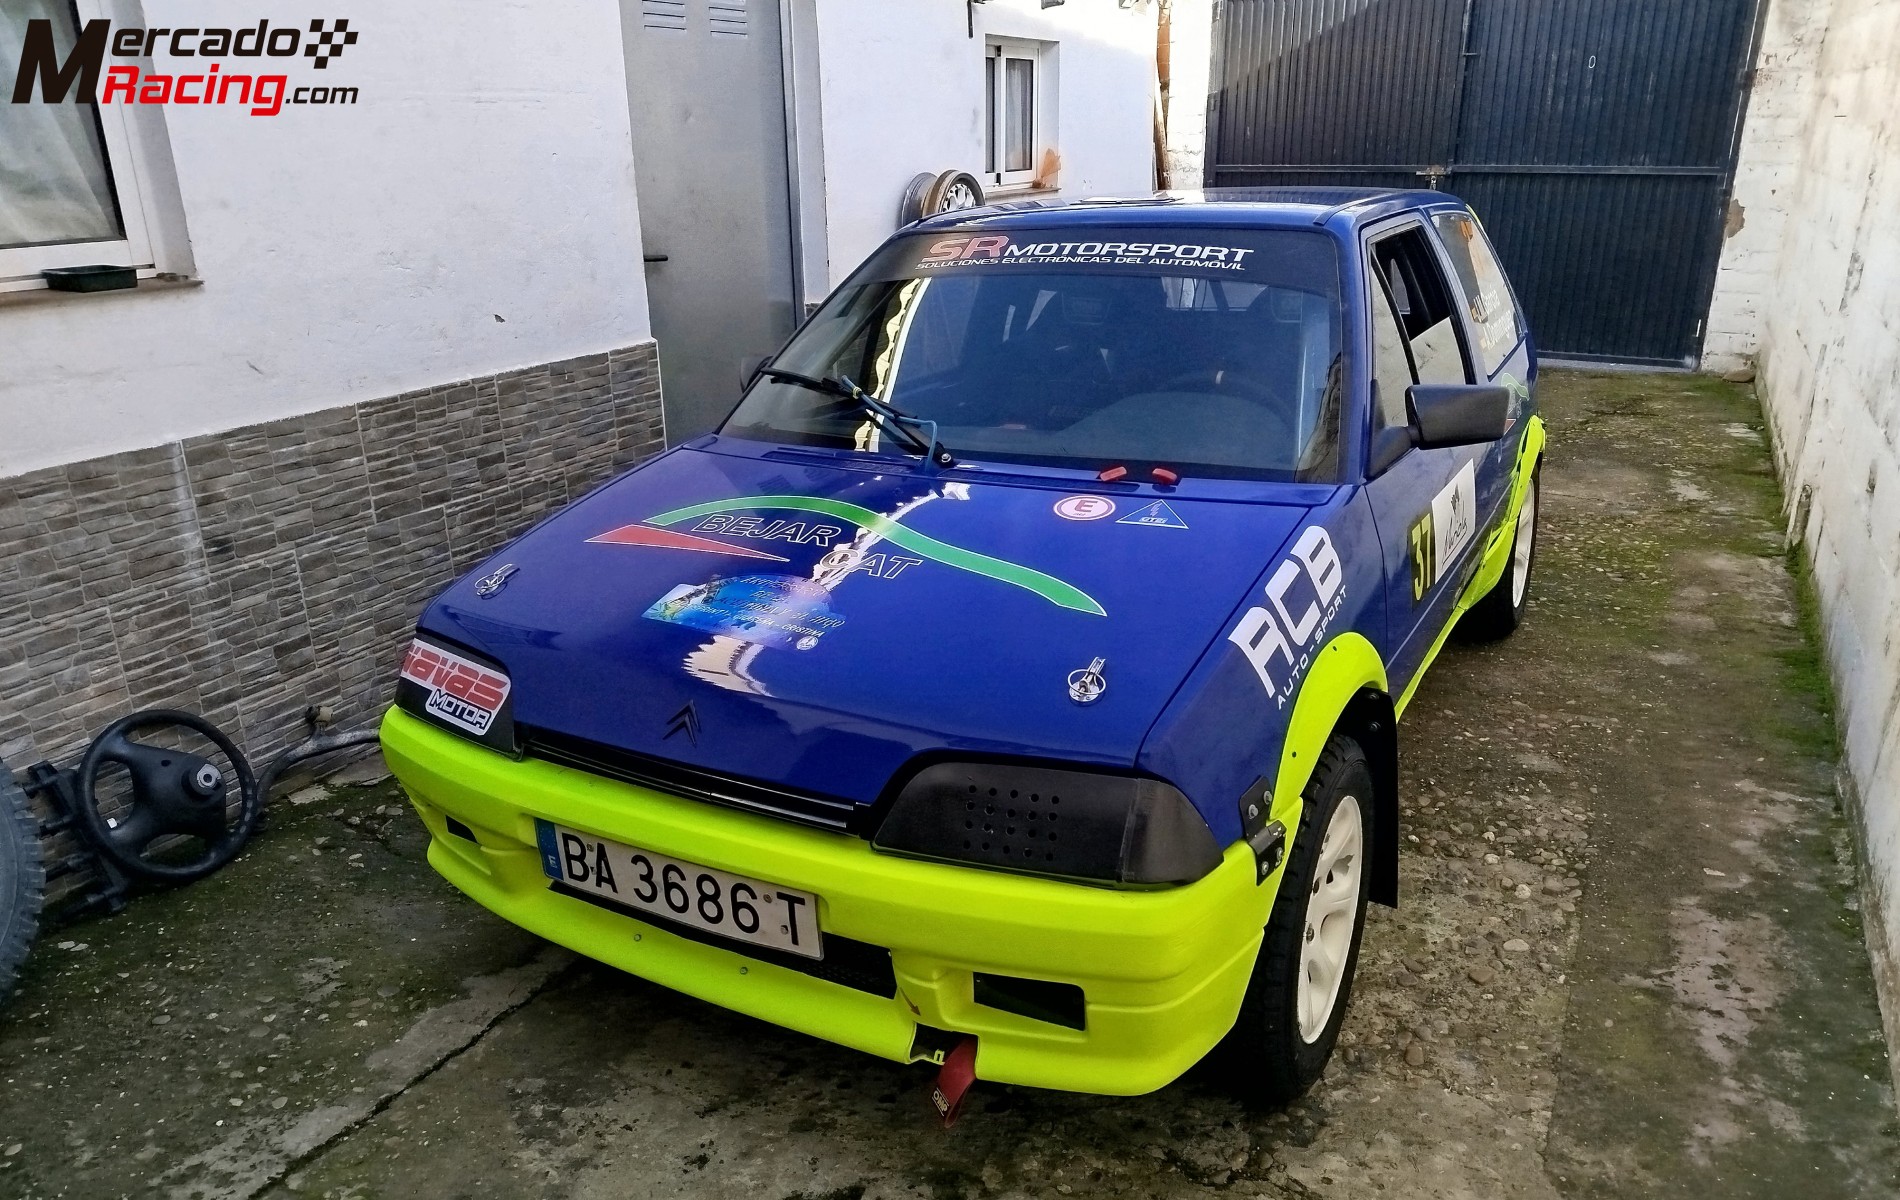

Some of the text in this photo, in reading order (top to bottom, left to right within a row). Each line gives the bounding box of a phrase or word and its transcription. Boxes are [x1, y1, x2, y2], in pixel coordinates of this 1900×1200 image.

[915, 257, 998, 270] SOLUCIONES
[1114, 256, 1145, 264] DEL
[1148, 257, 1245, 270] AUTOMÓVIL
[1074, 499, 1098, 513] E
[691, 514, 841, 547] BEJAR
[820, 549, 923, 579] CAT
[1411, 513, 1431, 601] 37
[782, 624, 825, 638] CRISTINA
[429, 689, 491, 729] MOTOR
[561, 832, 806, 946] BA 3686 T
